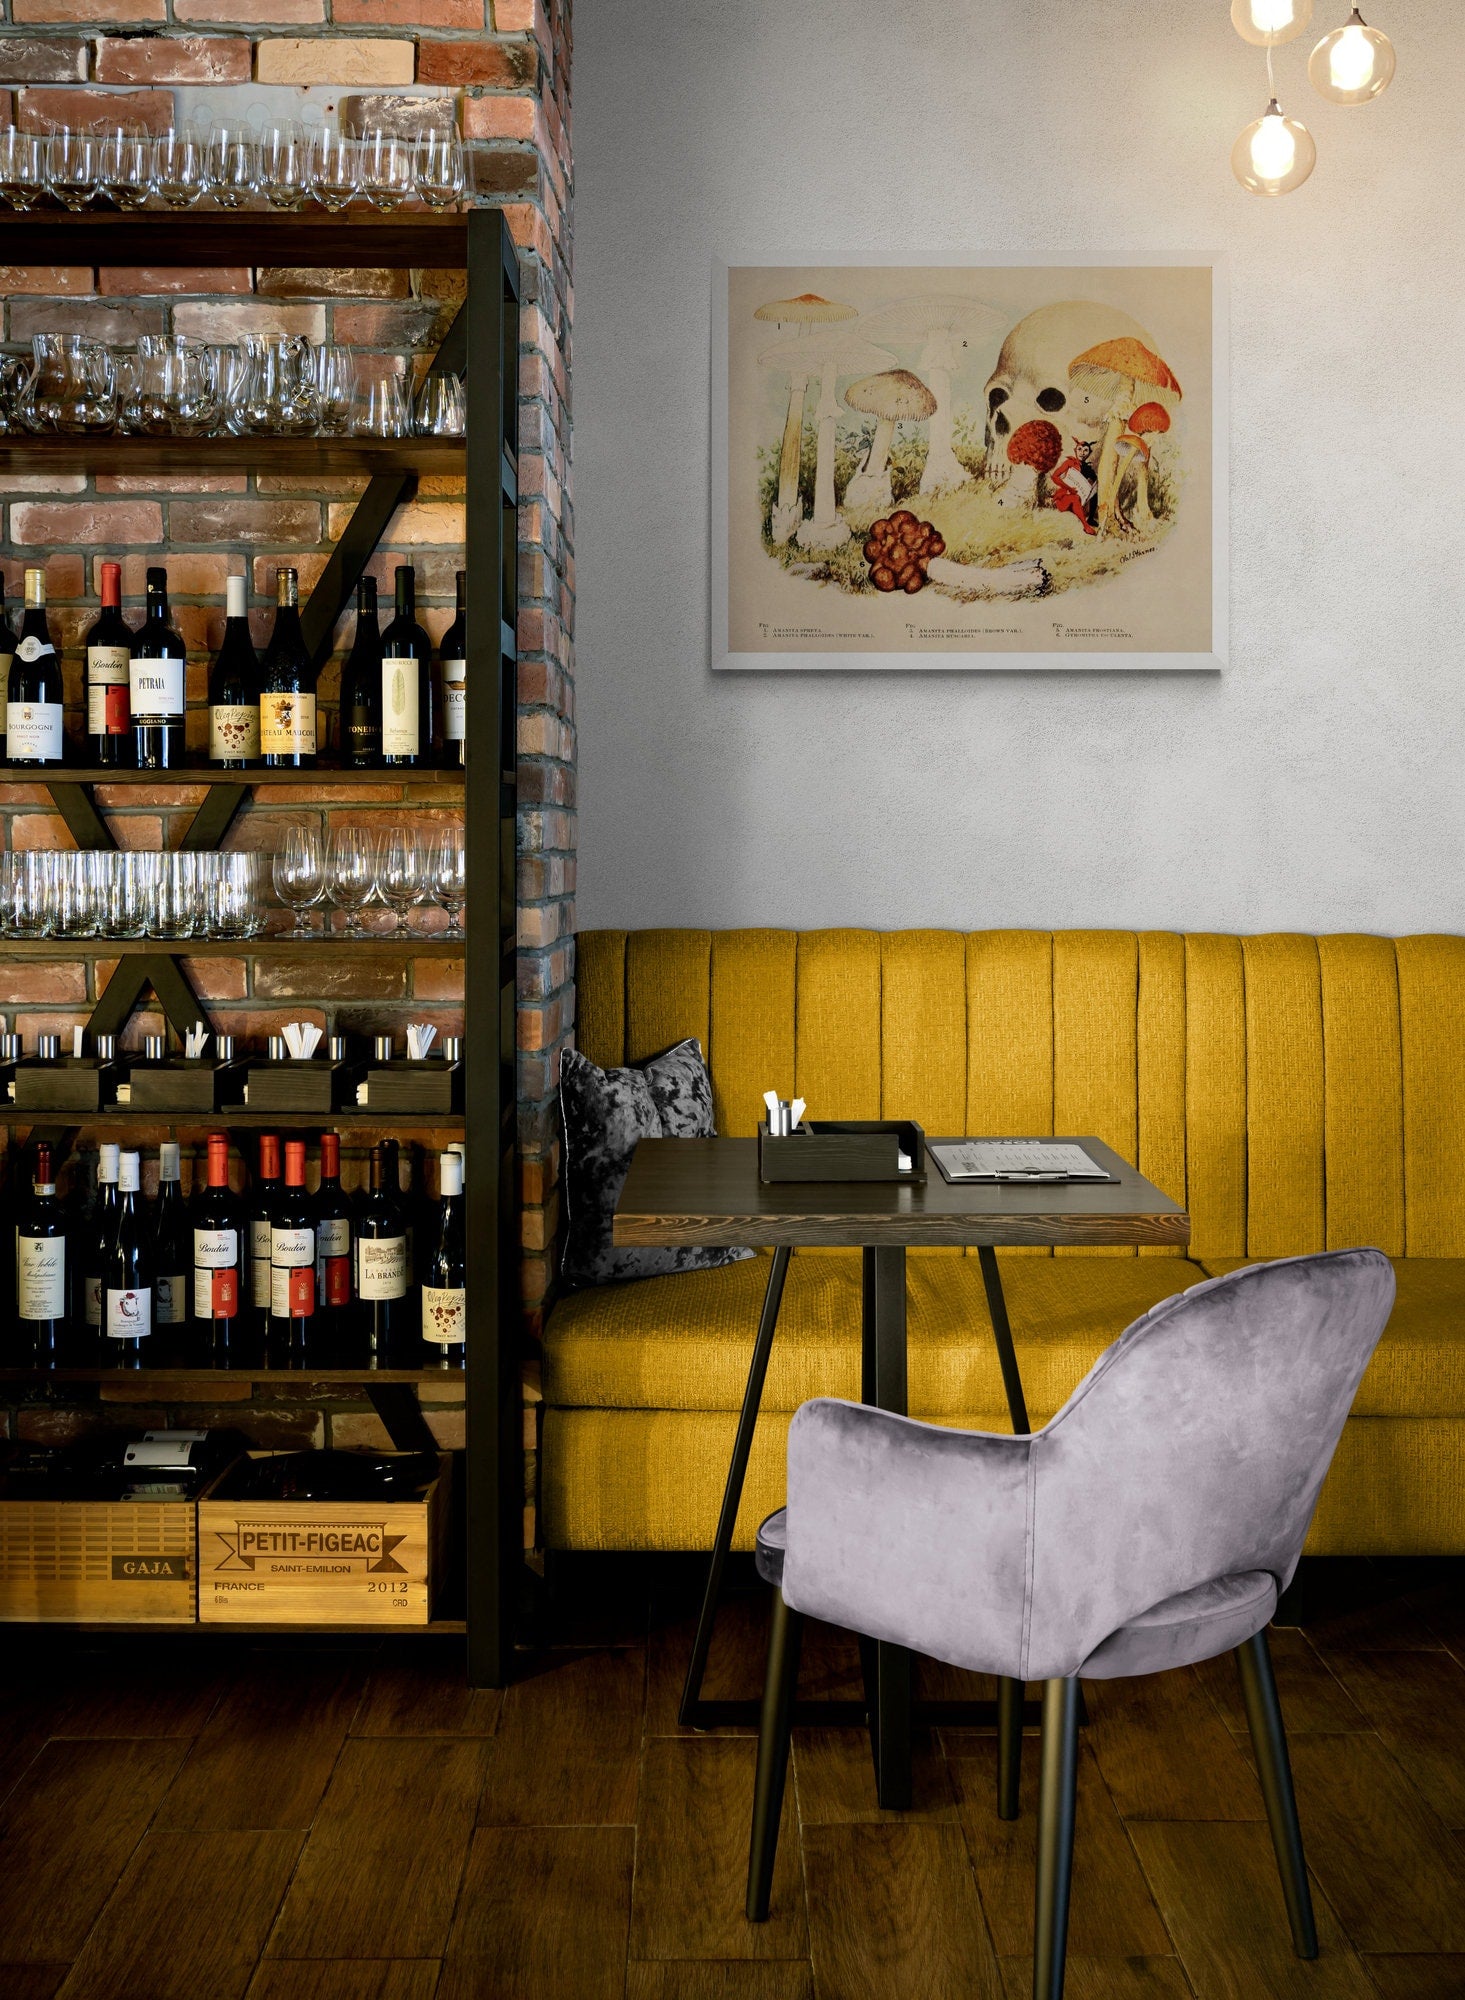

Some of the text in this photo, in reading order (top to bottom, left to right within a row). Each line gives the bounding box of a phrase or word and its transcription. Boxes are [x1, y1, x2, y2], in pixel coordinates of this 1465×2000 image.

[998, 498, 1004, 506] 4
[138, 677, 165, 689] PETRAIA
[199, 1243, 229, 1253] Bordón
[276, 1242, 306, 1252] Bordón
[243, 1532, 380, 1552] PETIT-FIGEAC
[123, 1561, 174, 1574] GAJA
[270, 1564, 351, 1573] SAINT-EMILION
[214, 1582, 265, 1591] FRANCE
[367, 1582, 408, 1593] 2012
